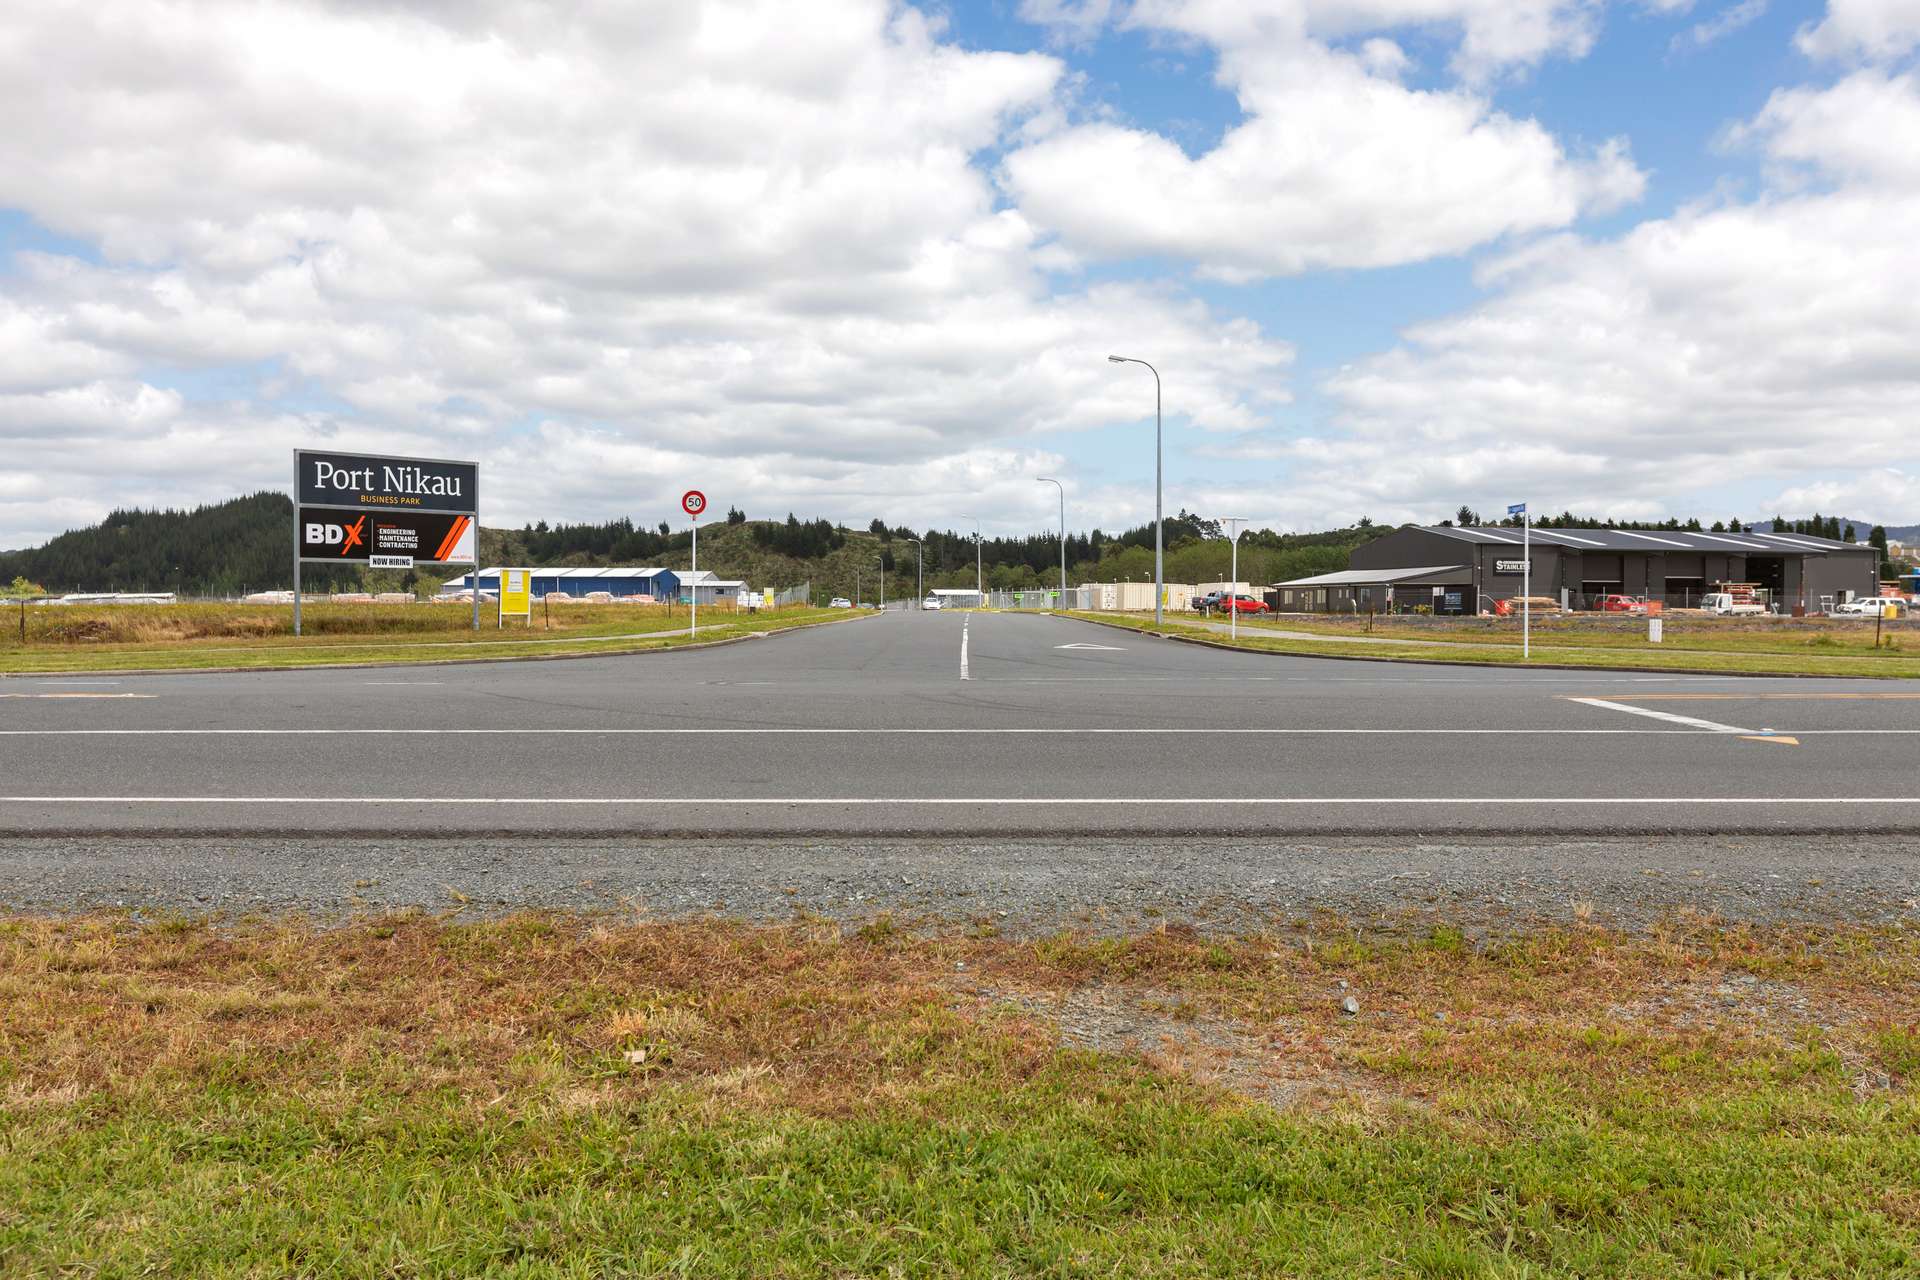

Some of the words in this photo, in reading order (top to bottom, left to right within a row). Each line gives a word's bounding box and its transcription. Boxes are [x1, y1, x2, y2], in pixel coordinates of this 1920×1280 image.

[314, 461, 375, 491] Port
[383, 466, 462, 496] Nikau
[360, 495, 399, 504] BUSINESS
[400, 497, 421, 505] PARK
[688, 497, 701, 507] 50
[305, 515, 366, 556] BDX
[372, 557, 388, 566] NOW
[389, 558, 411, 567] HIRING
[1496, 560, 1531, 570] STAINLE
